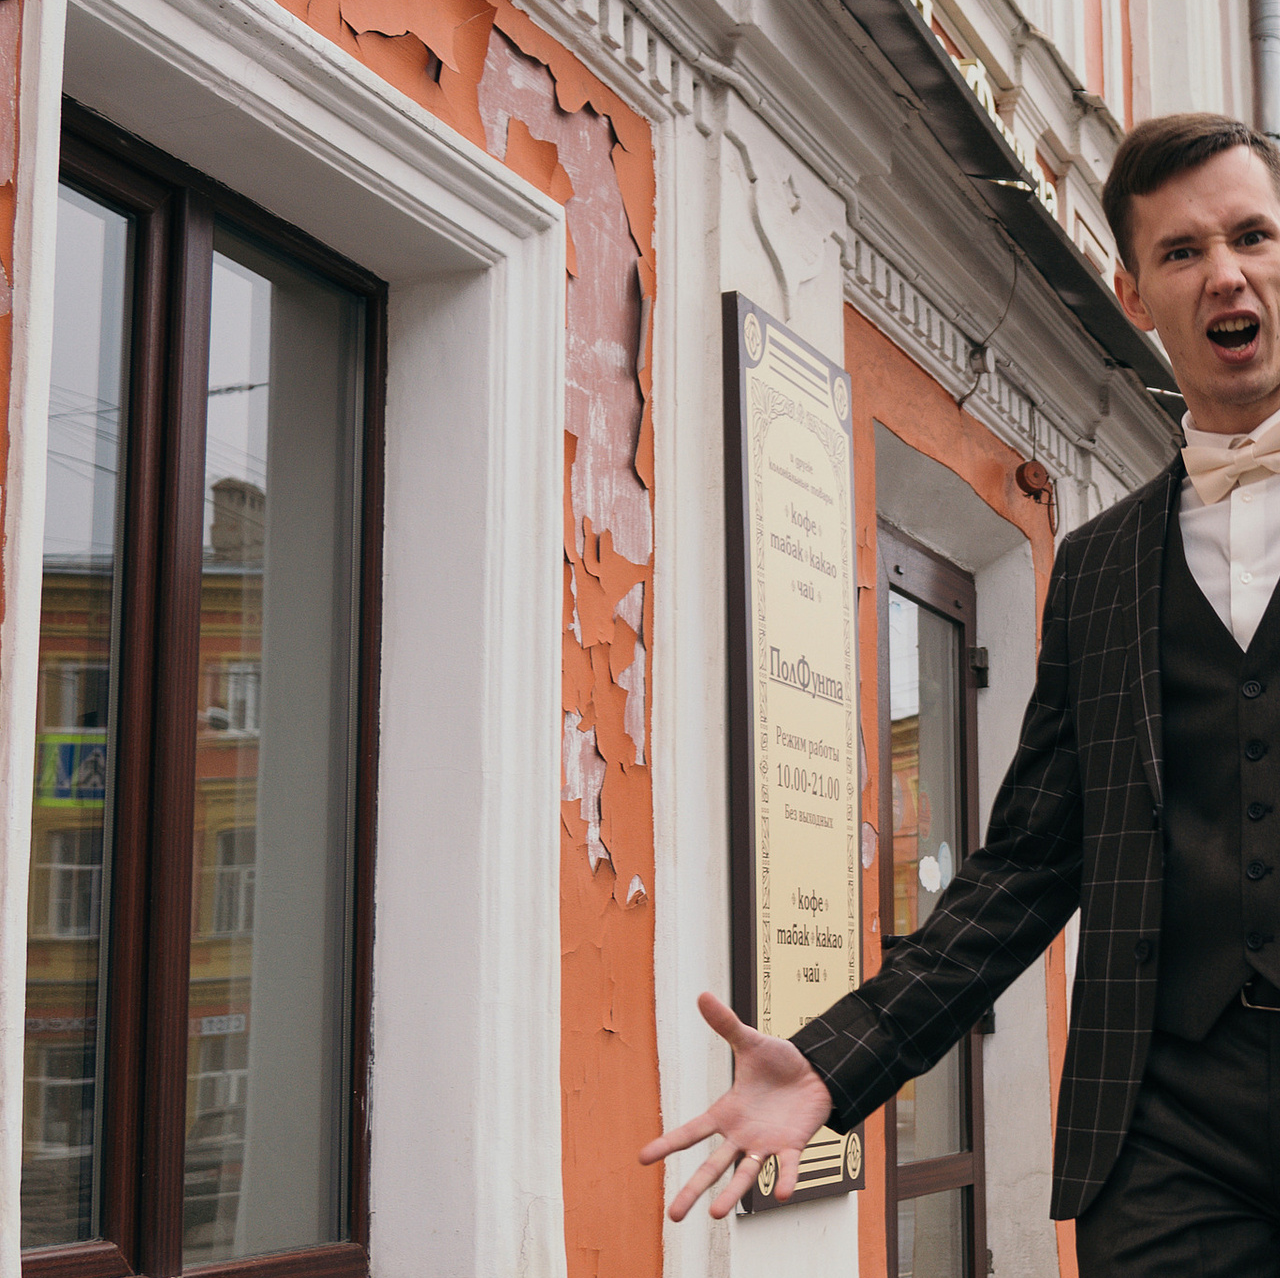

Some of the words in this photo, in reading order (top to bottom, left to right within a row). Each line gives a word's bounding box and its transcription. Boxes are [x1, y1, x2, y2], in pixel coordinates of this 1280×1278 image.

[790, 501, 817, 538] кофе
[770, 532, 804, 563] табак
[809, 545, 837, 579] какао
[797, 580, 815, 602] чай
[769, 645, 844, 700] ПолФунта
[776, 725, 807, 753] Режим
[808, 738, 840, 762] работы
[777, 762, 840, 801] 10.00-21.00
[785, 803, 798, 821] Без
[798, 810, 834, 829] выходных
[797, 887, 824, 918] кофе
[777, 924, 810, 947] табак
[815, 925, 843, 949] какао
[802, 962, 821, 983] чай
